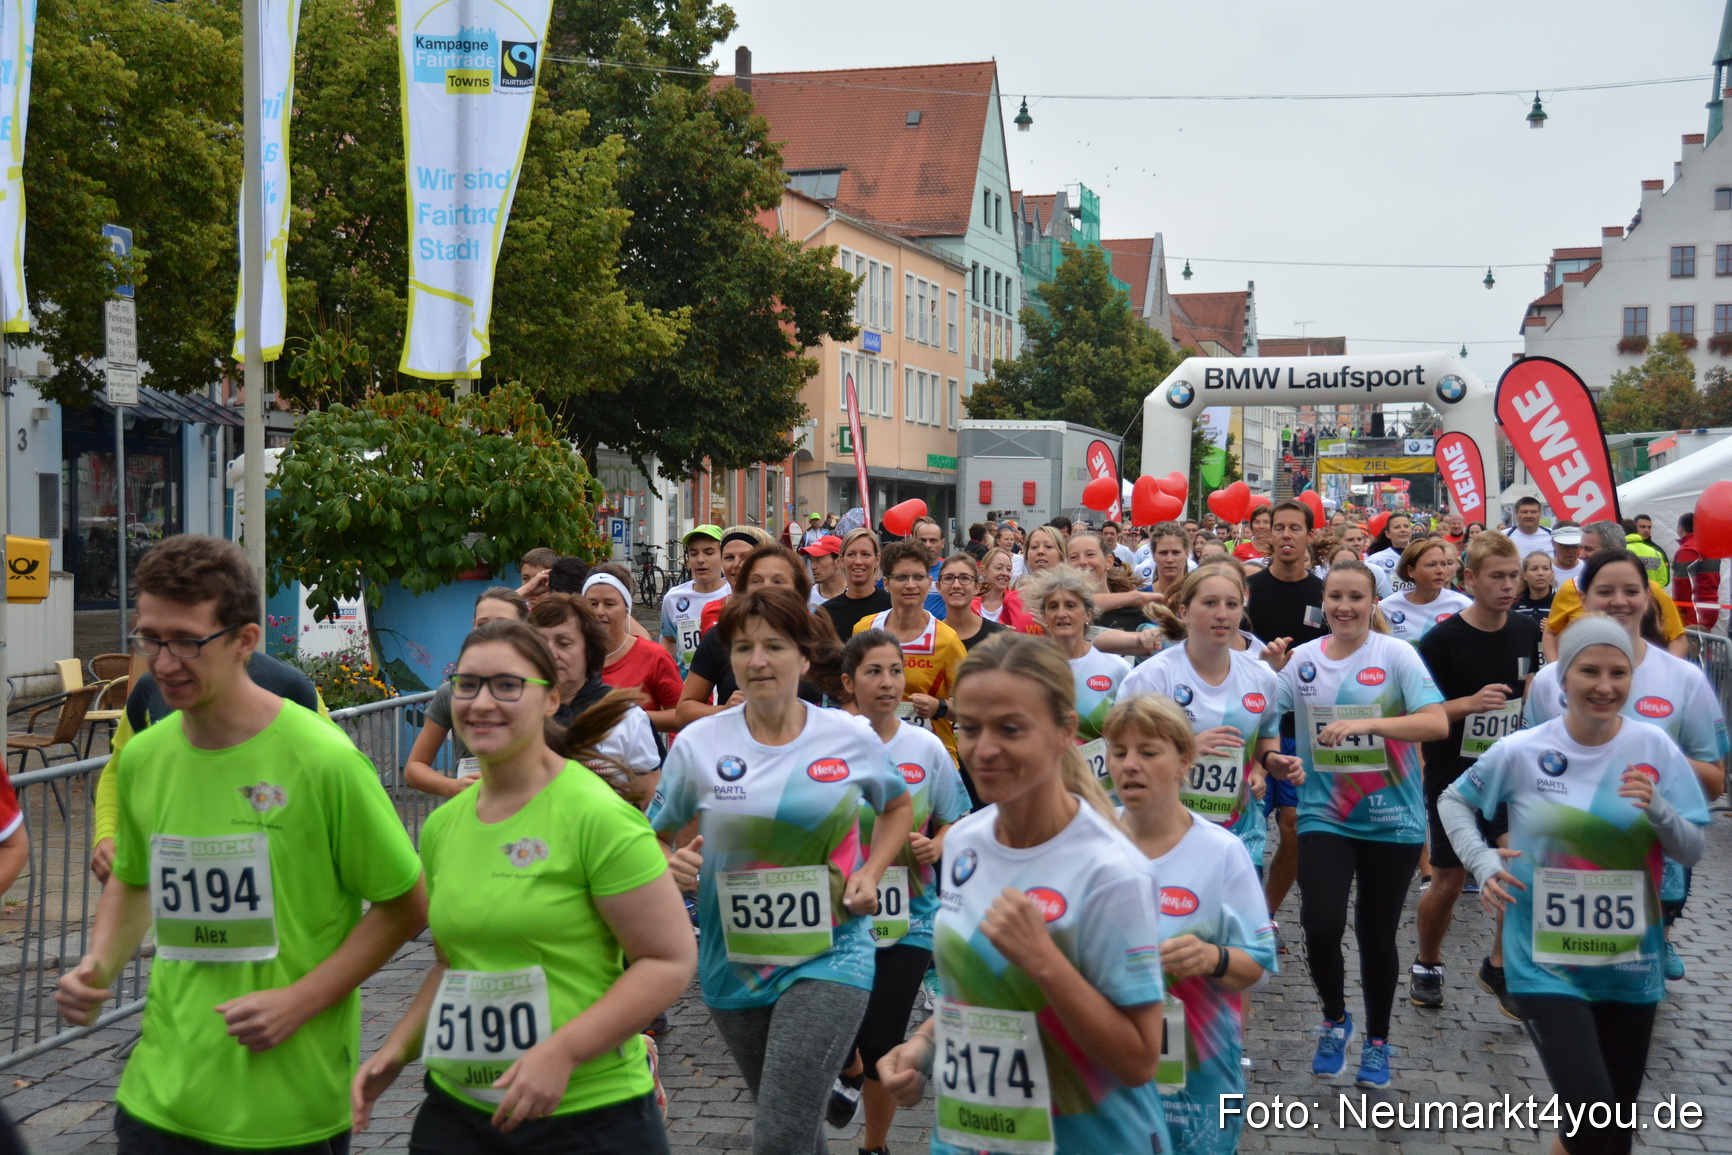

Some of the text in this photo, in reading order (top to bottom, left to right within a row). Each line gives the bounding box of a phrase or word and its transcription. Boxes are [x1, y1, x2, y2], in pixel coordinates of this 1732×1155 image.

[416, 36, 489, 52] Kampagne
[416, 50, 497, 68] Fairtrade
[448, 75, 490, 88] Towns
[502, 77, 535, 86] FAIRTRADE
[416, 166, 511, 191] Wir sind
[420, 238, 480, 261] Stadt
[1204, 365, 1426, 392] BMW Laufsport
[17, 427, 28, 451] 3
[1364, 461, 1390, 471] ZIEL
[614, 523, 622, 535] P
[1090, 679, 1110, 688] Hervis
[1360, 672, 1384, 682] Hervis
[1244, 697, 1265, 709] Hervis
[1338, 706, 1375, 716] BOCK
[1640, 700, 1670, 713] Hervis
[1472, 713, 1518, 738] 5019
[1335, 753, 1359, 764] Anna
[813, 763, 847, 776] Hervis
[714, 785, 747, 795] PARTL
[1537, 778, 1568, 790] PARTL
[1537, 787, 1568, 796] Neumarkt
[1368, 794, 1387, 806] 17.
[1369, 804, 1409, 814] Neumarkter
[191, 837, 256, 856] BOCK
[765, 869, 820, 884] BOCK
[1583, 874, 1634, 887] BOCK
[161, 866, 261, 914] 5194
[731, 890, 821, 929] 5320
[1545, 891, 1635, 930] 5185
[194, 925, 229, 944] Alex
[1561, 936, 1618, 953] Kristina
[470, 974, 535, 993] BOCK
[436, 1001, 538, 1053] 5190
[967, 1012, 1024, 1034] BOCK
[943, 1037, 1036, 1098] 5174
[465, 1066, 504, 1086] Julia
[958, 1106, 1017, 1134] Claudia
